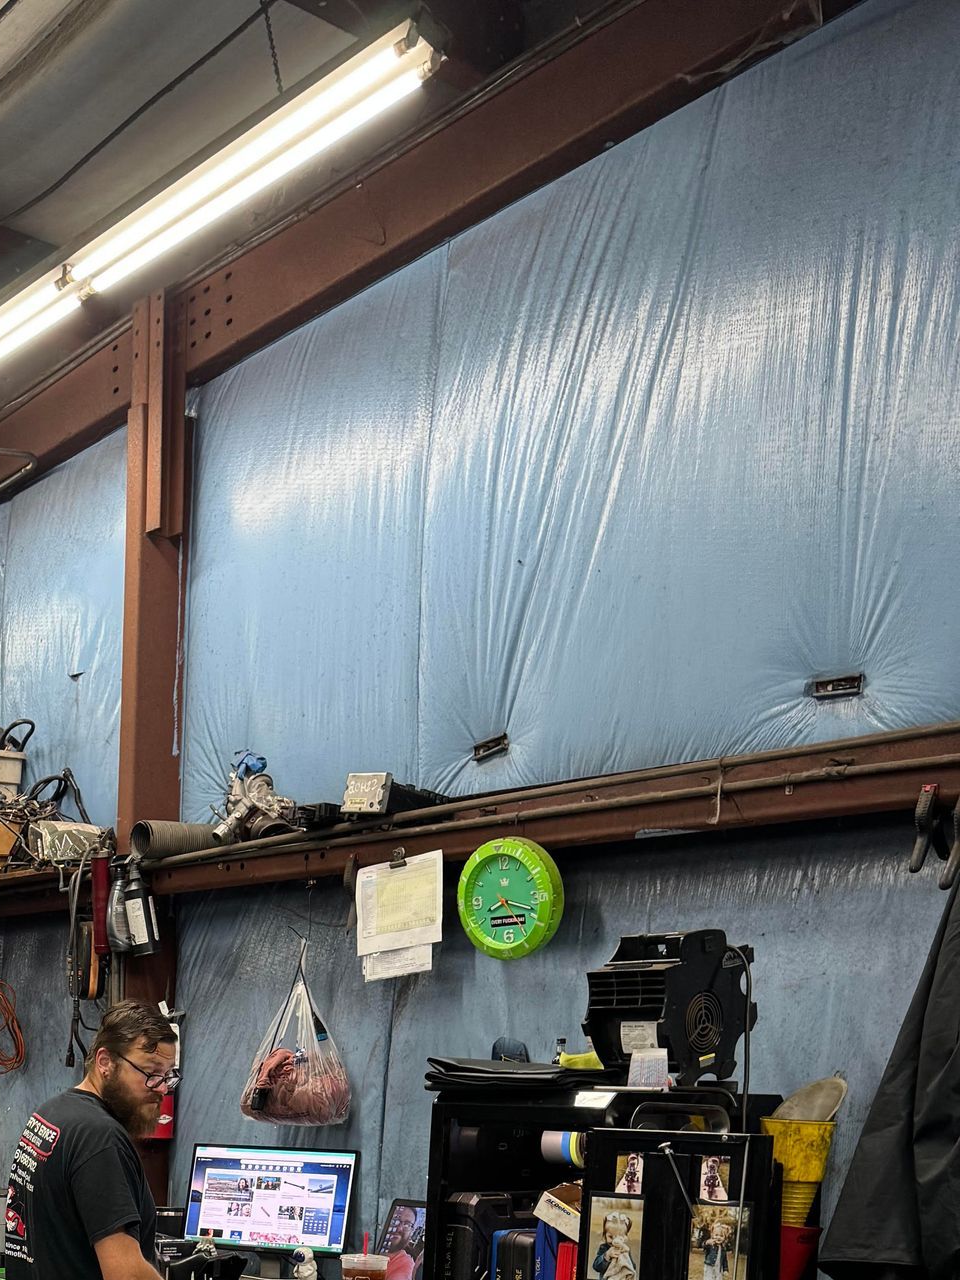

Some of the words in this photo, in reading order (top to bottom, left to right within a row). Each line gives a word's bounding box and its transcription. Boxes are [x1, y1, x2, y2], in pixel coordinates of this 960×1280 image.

[498, 856, 510, 870] 12
[472, 897, 483, 910] 9
[530, 890, 540, 905] 3
[503, 929, 514, 943] 6
